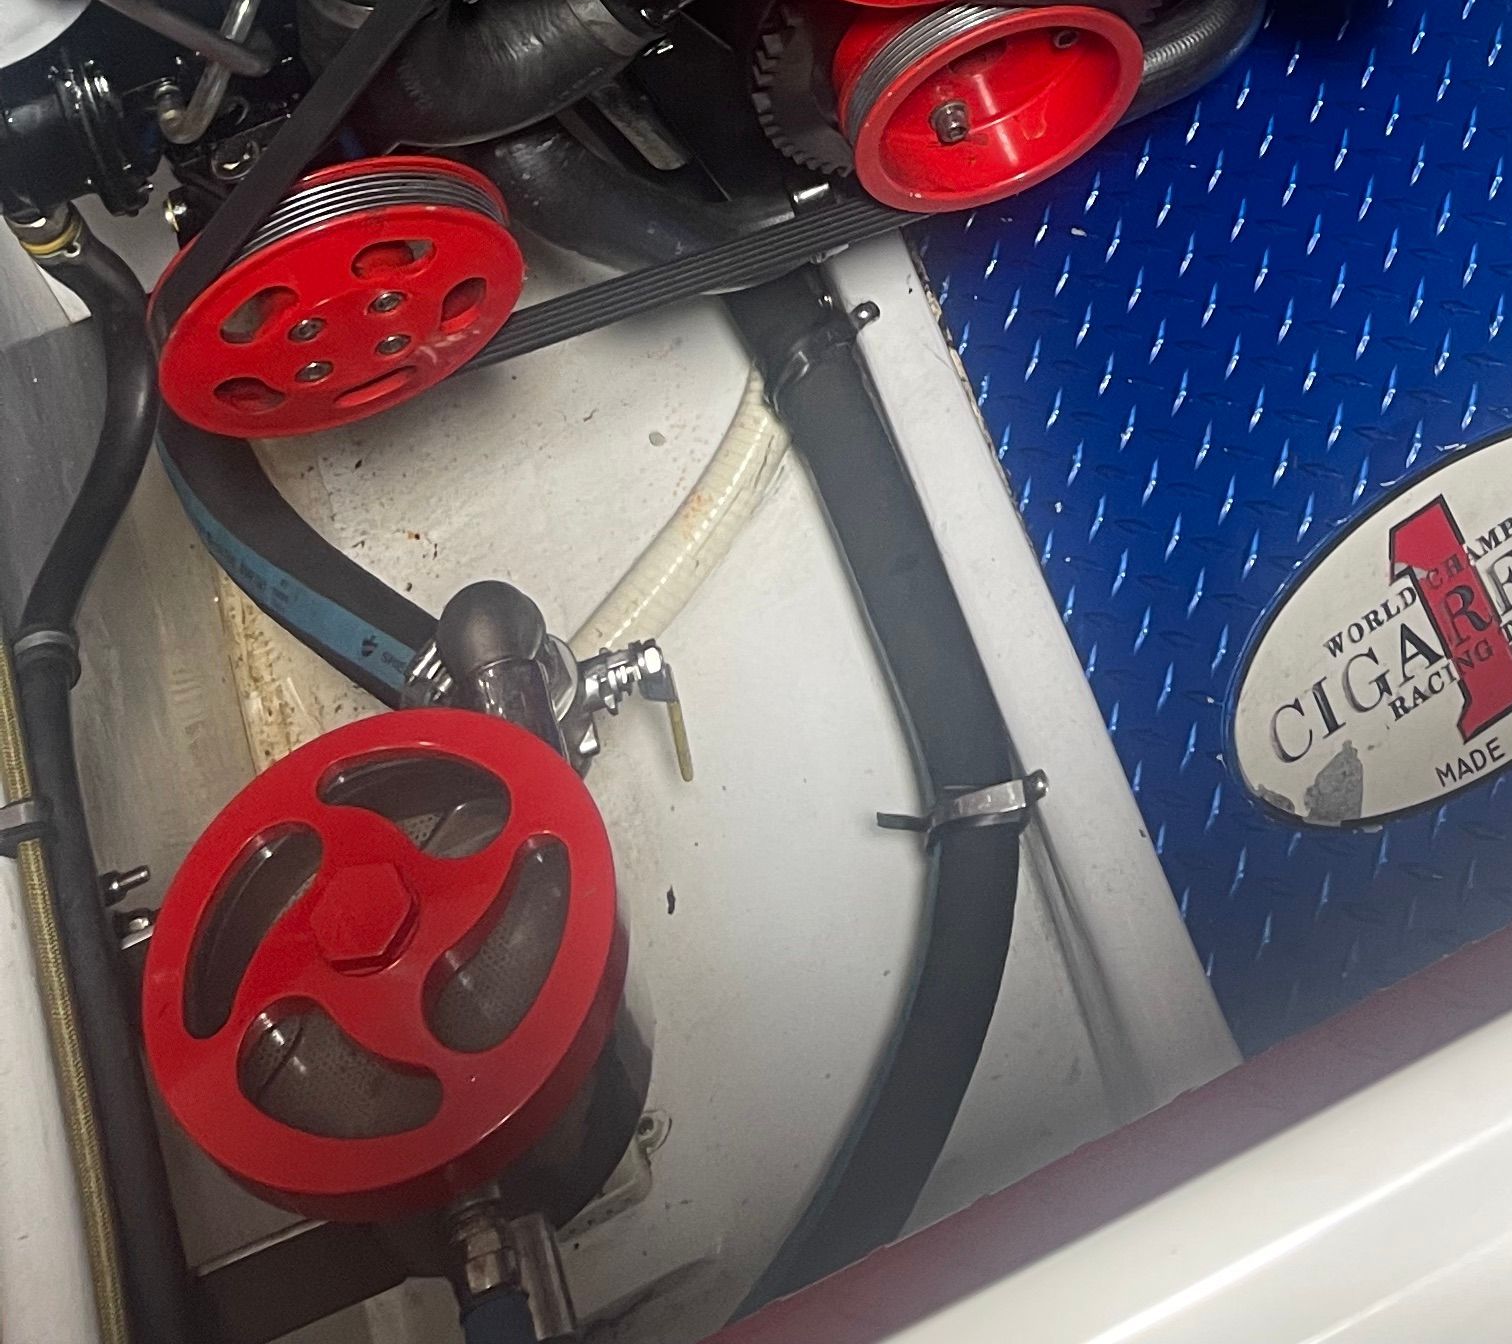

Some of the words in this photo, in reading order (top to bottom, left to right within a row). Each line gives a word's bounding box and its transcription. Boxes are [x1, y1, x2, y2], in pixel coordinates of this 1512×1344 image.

[1323, 587, 1417, 658] WORLD
[1387, 640, 1495, 722] RACING
[1435, 743, 1506, 789] MADE
